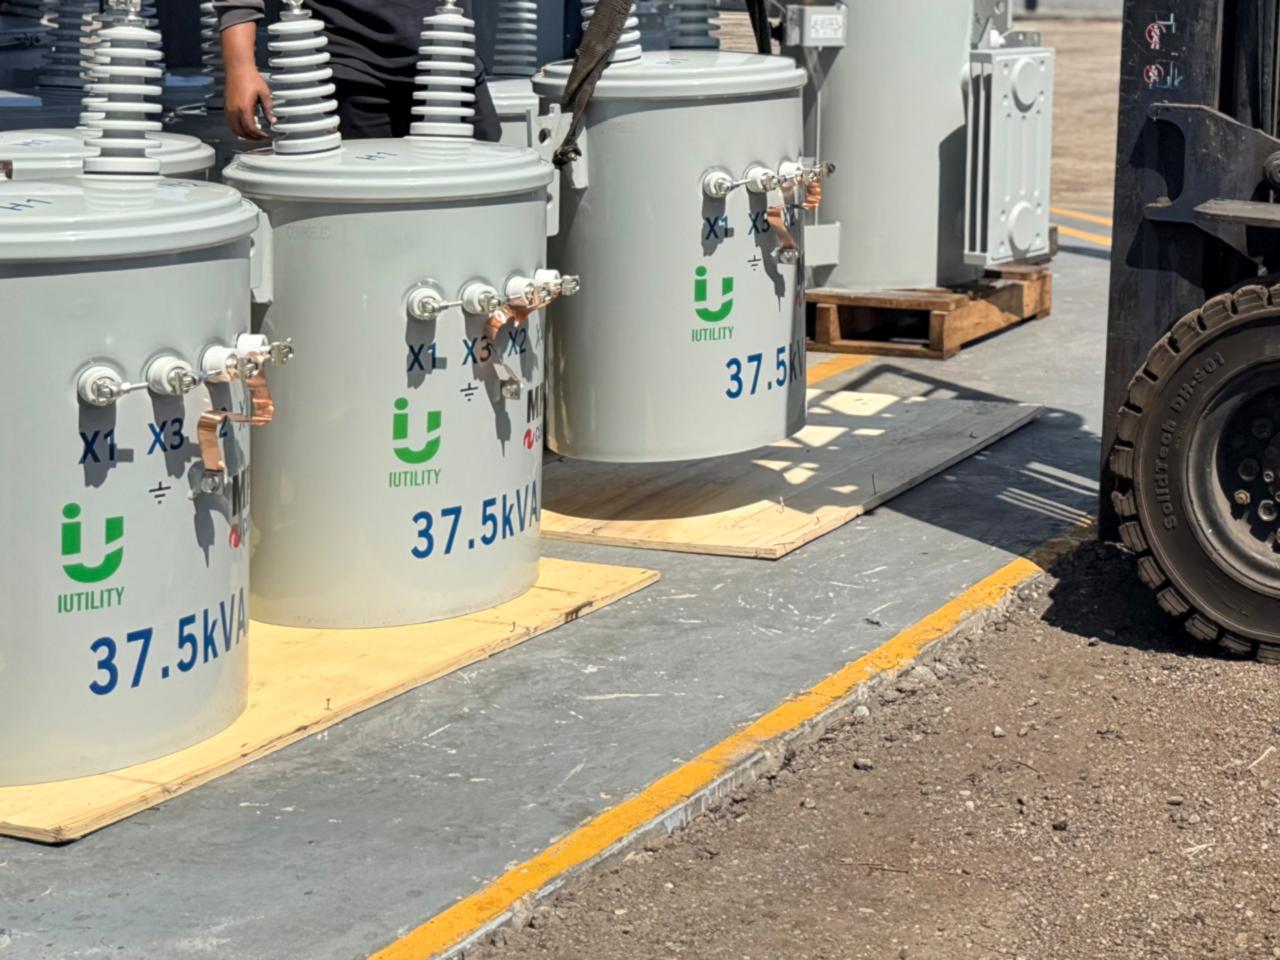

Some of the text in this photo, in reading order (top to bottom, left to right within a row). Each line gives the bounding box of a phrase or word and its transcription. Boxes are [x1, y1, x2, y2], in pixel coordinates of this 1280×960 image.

[704, 215, 729, 241] X1
[407, 342, 438, 372] X1
[462, 336, 494, 366] X3
[508, 327, 528, 357] X2
[78, 427, 117, 465] X1
[147, 417, 186, 456] X3
[389, 468, 441, 488] IUTILITY
[57, 586, 125, 614] IUTILITY
[88, 586, 248, 696] 37.5kVA
